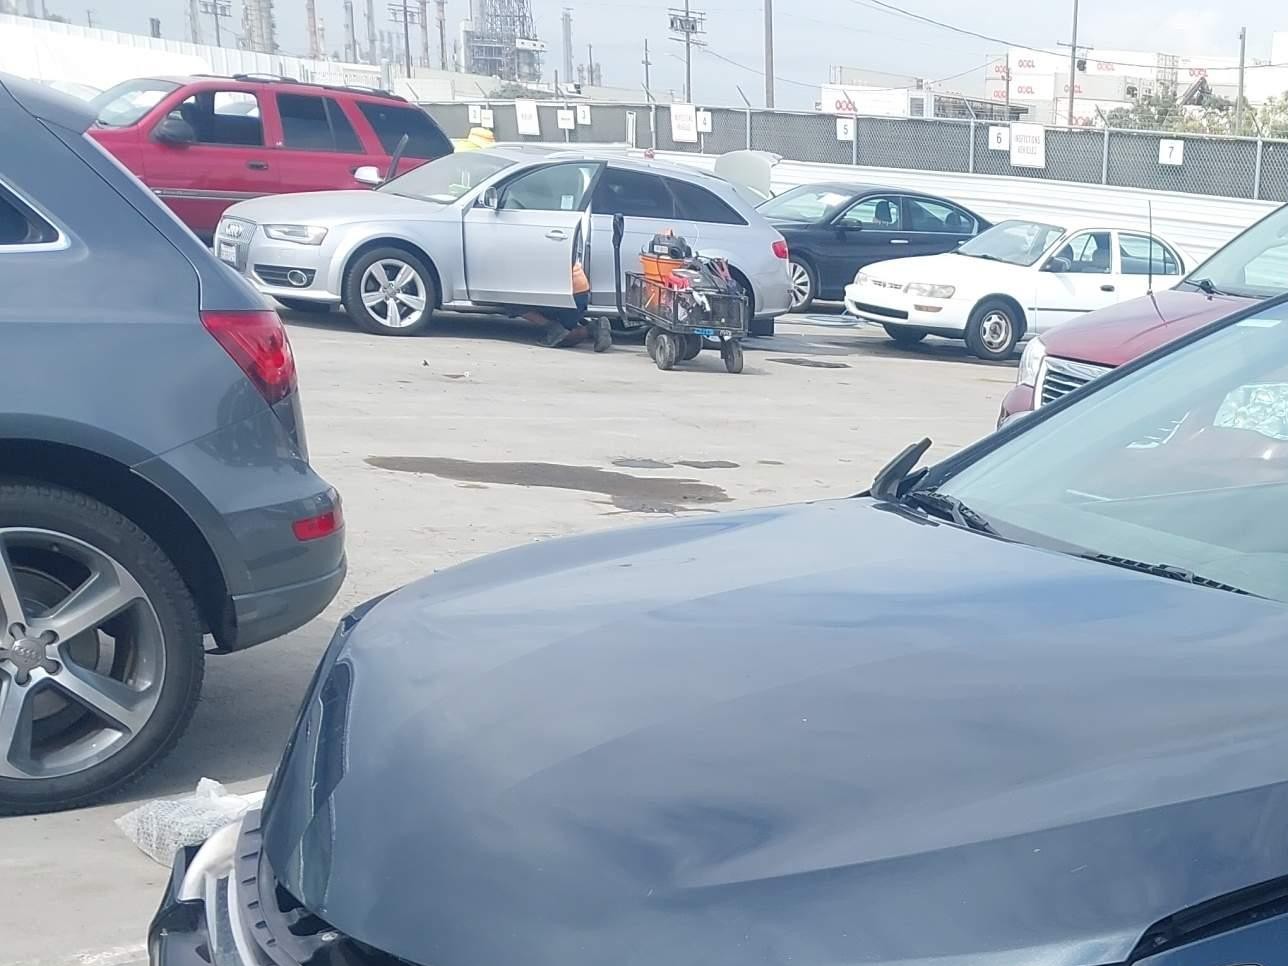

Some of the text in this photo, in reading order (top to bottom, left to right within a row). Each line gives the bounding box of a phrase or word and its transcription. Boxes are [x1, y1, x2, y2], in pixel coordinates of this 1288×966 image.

[1064, 84, 1082, 93] OCL
[843, 124, 849, 135] 5
[996, 132, 1002, 144] 6
[1168, 145, 1175, 160] 7
